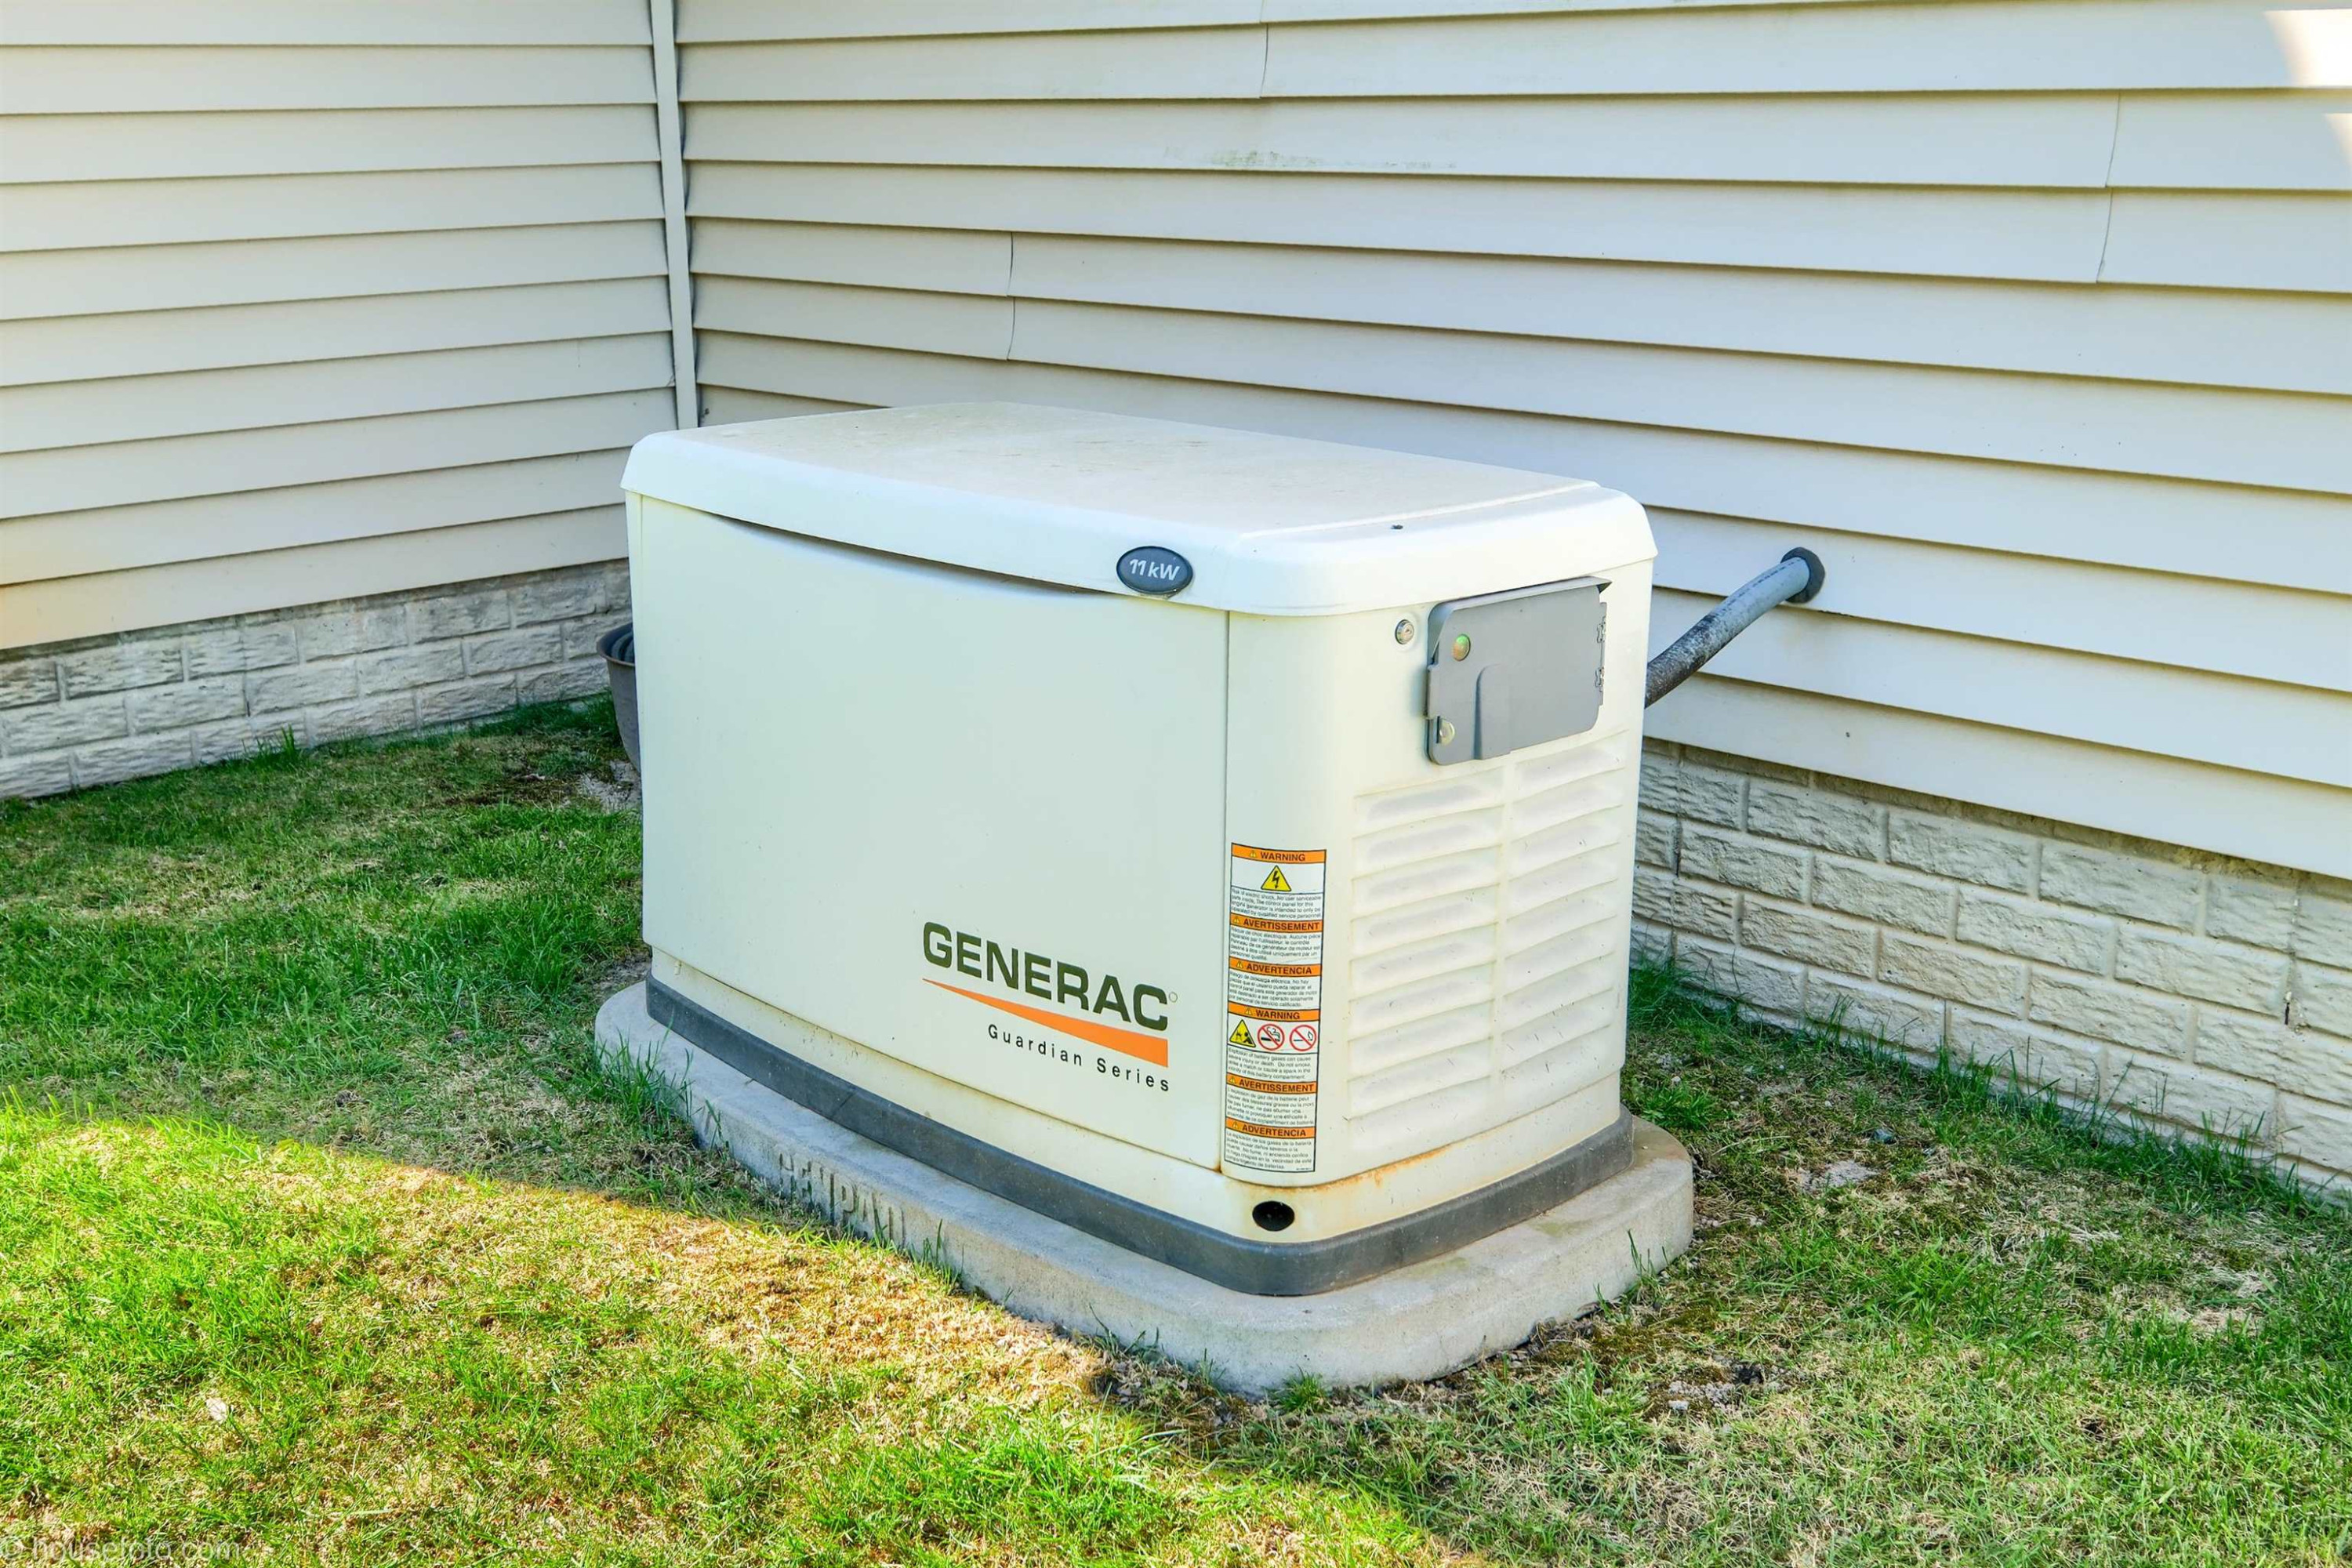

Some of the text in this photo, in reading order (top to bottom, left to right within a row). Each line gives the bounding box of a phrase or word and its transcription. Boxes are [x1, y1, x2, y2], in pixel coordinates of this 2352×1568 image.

[1260, 851, 1305, 862] WARNING
[1243, 918, 1319, 931] AVERTISSEMENT
[1247, 964, 1312, 974] ADVERTENCIA
[923, 921, 1168, 1032] GENERAC
[1255, 1010, 1301, 1019] WARNING
[988, 1024, 1169, 1092] Guardian Series
[1239, 1079, 1314, 1091] AVERTISSEMENT
[1242, 1123, 1306, 1136] ADVERTENCIA
